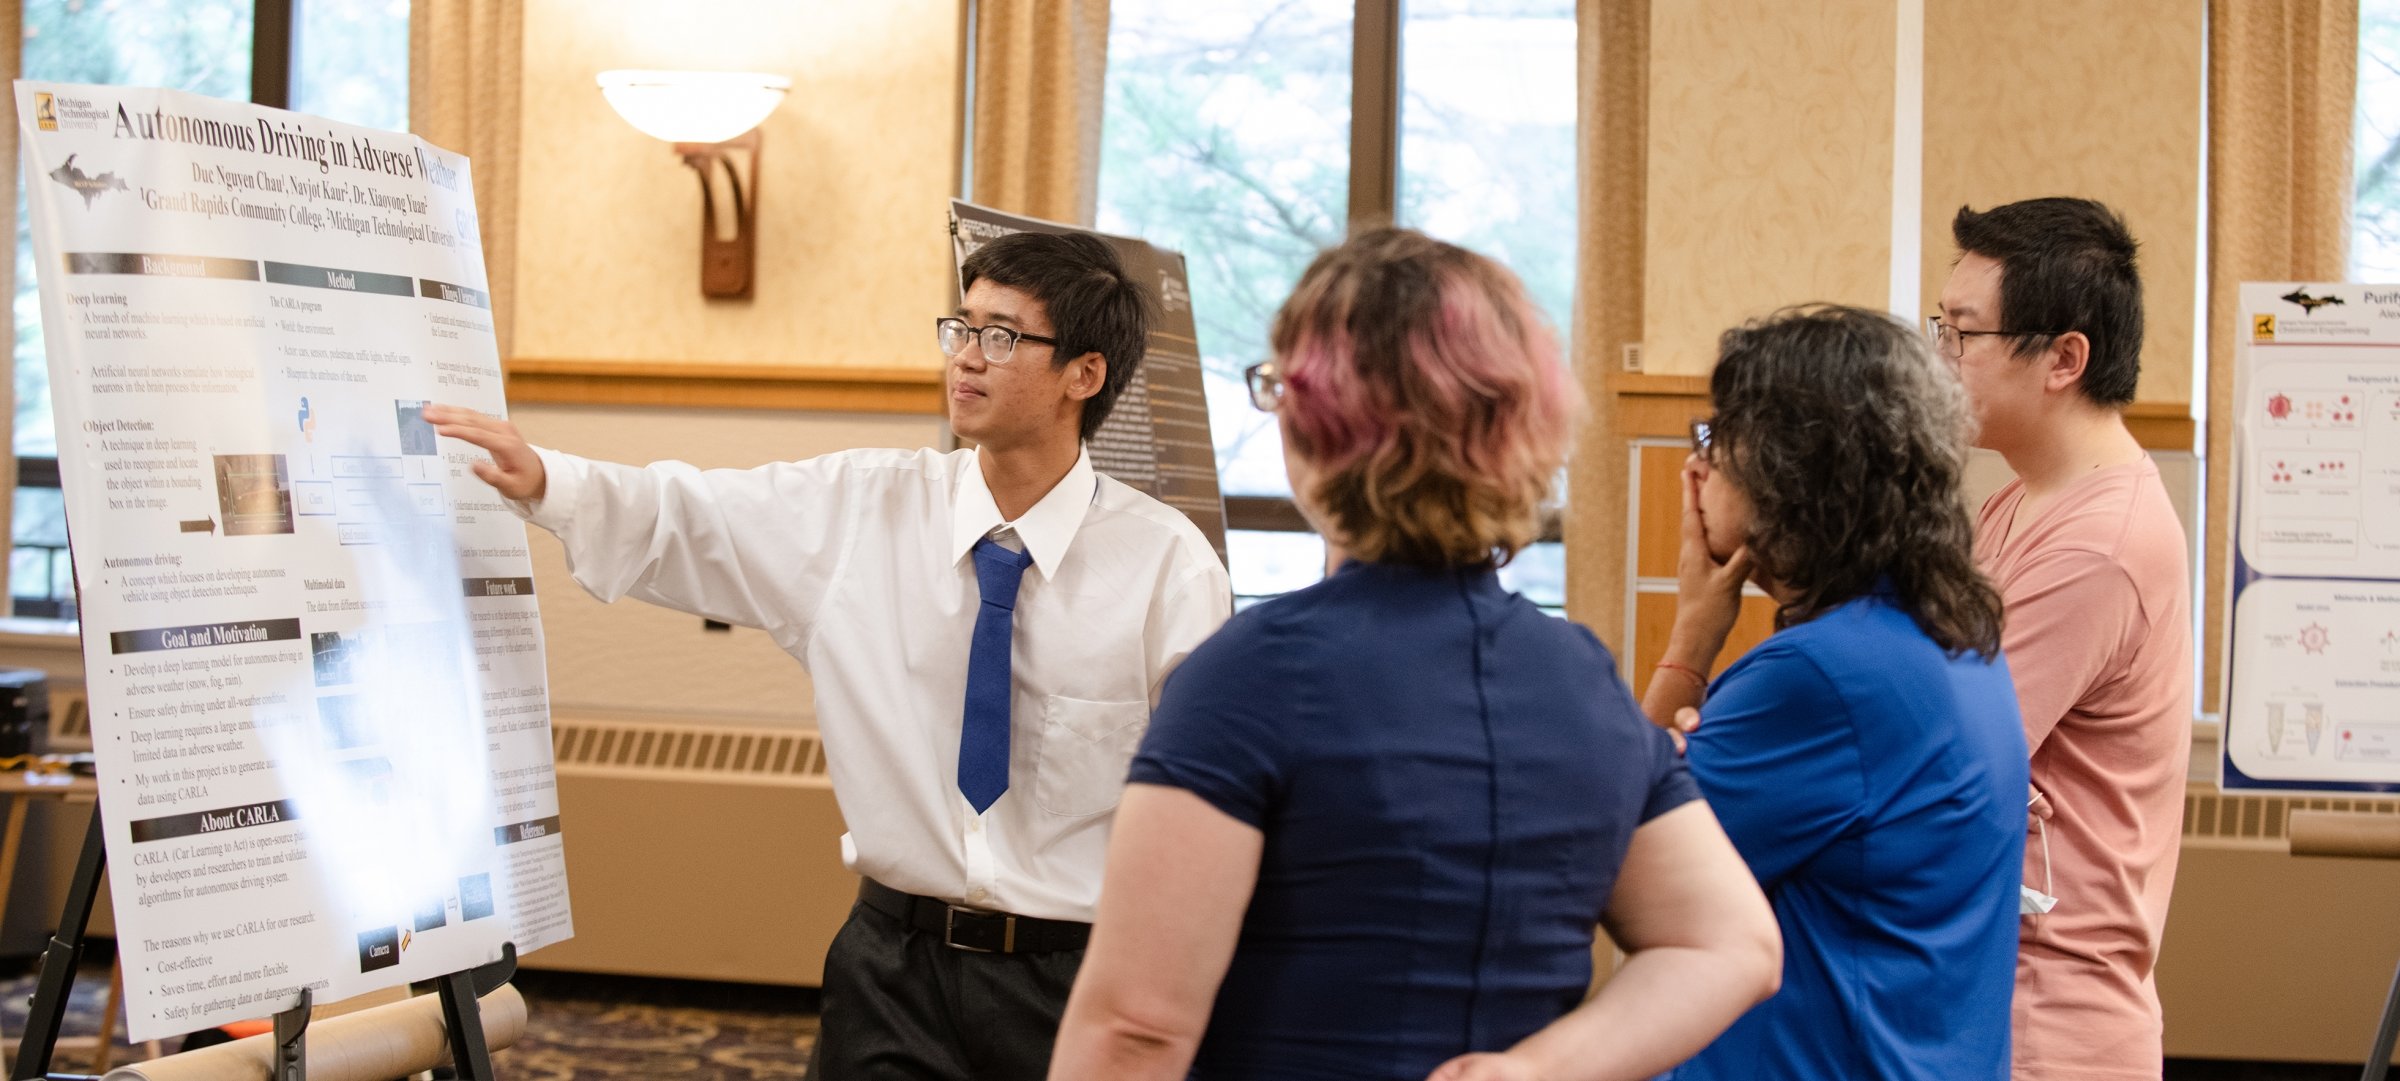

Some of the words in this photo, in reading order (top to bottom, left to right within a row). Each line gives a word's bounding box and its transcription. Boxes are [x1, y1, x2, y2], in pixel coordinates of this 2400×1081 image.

[57, 98, 92, 111] Michigan
[58, 108, 110, 121] Technological
[113, 101, 255, 155] Autonomous
[257, 118, 330, 173] Driving
[329, 129, 349, 168] in
[352, 137, 413, 179] Adverse
[414, 146, 458, 193] Weather
[192, 162, 213, 184] Duc
[216, 165, 254, 192] Nguyen
[290, 176, 321, 202] Navjot
[191, 193, 230, 218] Rapids
[231, 197, 286, 221] Community
[290, 206, 326, 231] College,
[373, 218, 426, 244] Technological
[143, 256, 206, 276] Background
[327, 272, 356, 289] Method
[66, 294, 90, 307] Deep
[92, 293, 128, 306] learning
[280, 297, 301, 310] CARLA
[301, 302, 323, 313] program
[85, 327, 111, 339] neural
[112, 327, 148, 339] networks.
[83, 420, 114, 435] Object
[116, 419, 155, 431] Detection:
[110, 440, 144, 453] technique
[154, 440, 170, 452] deep
[171, 440, 198, 453] learning
[104, 458, 123, 471] used
[133, 460, 165, 472] recognize
[179, 457, 199, 469] locate
[121, 478, 142, 492] object
[144, 477, 165, 488] within
[171, 476, 202, 490] bounding
[147, 499, 168, 511] image.
[103, 558, 154, 568] Autonomous
[154, 554, 183, 567] driving:
[129, 576, 156, 588] concept
[158, 572, 178, 584] which
[179, 573, 204, 583] focuses
[216, 568, 251, 583] developing
[304, 579, 334, 590] Multimodal
[334, 579, 346, 589] data
[485, 580, 504, 595] Future
[504, 580, 517, 594] work
[122, 590, 149, 603] vehicle
[150, 591, 169, 603] using
[170, 588, 191, 602] object
[192, 586, 222, 598] detection
[224, 584, 259, 597] techniques.
[162, 630, 188, 648] Goal
[191, 628, 212, 646] and
[214, 625, 268, 643] Motivation
[124, 663, 157, 677] Develop
[164, 660, 181, 675] deep
[182, 660, 210, 672] learning
[211, 655, 232, 668] model
[233, 654, 243, 666] for
[244, 654, 278, 665] autonomous
[279, 651, 297, 664] driving
[126, 683, 155, 696] adverse
[156, 680, 184, 692] weather
[186, 680, 209, 692] (snow,
[210, 675, 225, 690] fog,
[225, 674, 244, 686] rain).
[128, 707, 156, 719] Ensure
[157, 703, 179, 717] safety
[180, 702, 206, 715] driving
[206, 698, 226, 711] under
[227, 695, 262, 709] all-weather
[131, 731, 153, 744] Deep
[154, 727, 183, 741] learning
[184, 726, 213, 739] requires
[220, 721, 237, 735] large
[132, 748, 162, 763] limited
[162, 747, 178, 759] data
[188, 744, 215, 756] adverse
[216, 740, 245, 752] weather.
[152, 770, 171, 783] work
[182, 768, 195, 780] this
[196, 766, 222, 781] project
[238, 761, 266, 776] generate
[138, 793, 155, 806] data
[156, 791, 177, 804] using
[178, 786, 209, 800] CARLA
[200, 813, 235, 832] About
[236, 805, 280, 826] CARLA
[519, 824, 546, 839] References
[134, 851, 169, 866] CARLA
[172, 848, 189, 863] (Car
[191, 844, 224, 858] Learning
[233, 840, 249, 851] Act)
[256, 834, 293, 850] open-source
[150, 869, 192, 884] developers
[193, 864, 206, 877] and
[208, 859, 247, 874] researchers
[256, 856, 272, 867] train
[272, 852, 284, 864] and
[138, 889, 182, 907] algorithms
[183, 886, 195, 899] for
[196, 881, 239, 896] autonomous
[240, 877, 265, 889] driving
[265, 873, 289, 887] system.
[144, 939, 160, 952] The
[161, 936, 191, 949] reasons
[193, 931, 210, 945] why
[223, 928, 235, 938] use
[236, 921, 266, 936] CARLA
[266, 918, 276, 931] for
[277, 918, 289, 928] our
[290, 911, 316, 926] research:
[369, 943, 390, 957] Camera
[158, 955, 213, 973] Cost-effective
[161, 985, 185, 997] Saves
[187, 980, 206, 992] time,
[208, 975, 228, 988] effort
[229, 971, 242, 984] and
[243, 970, 261, 981] more
[263, 962, 289, 977] flexible
[164, 1006, 190, 1020] Safety
[191, 1002, 202, 1015] for
[204, 998, 236, 1016] gathering
[237, 994, 252, 1006] data
[264, 986, 300, 1001] dangerous
